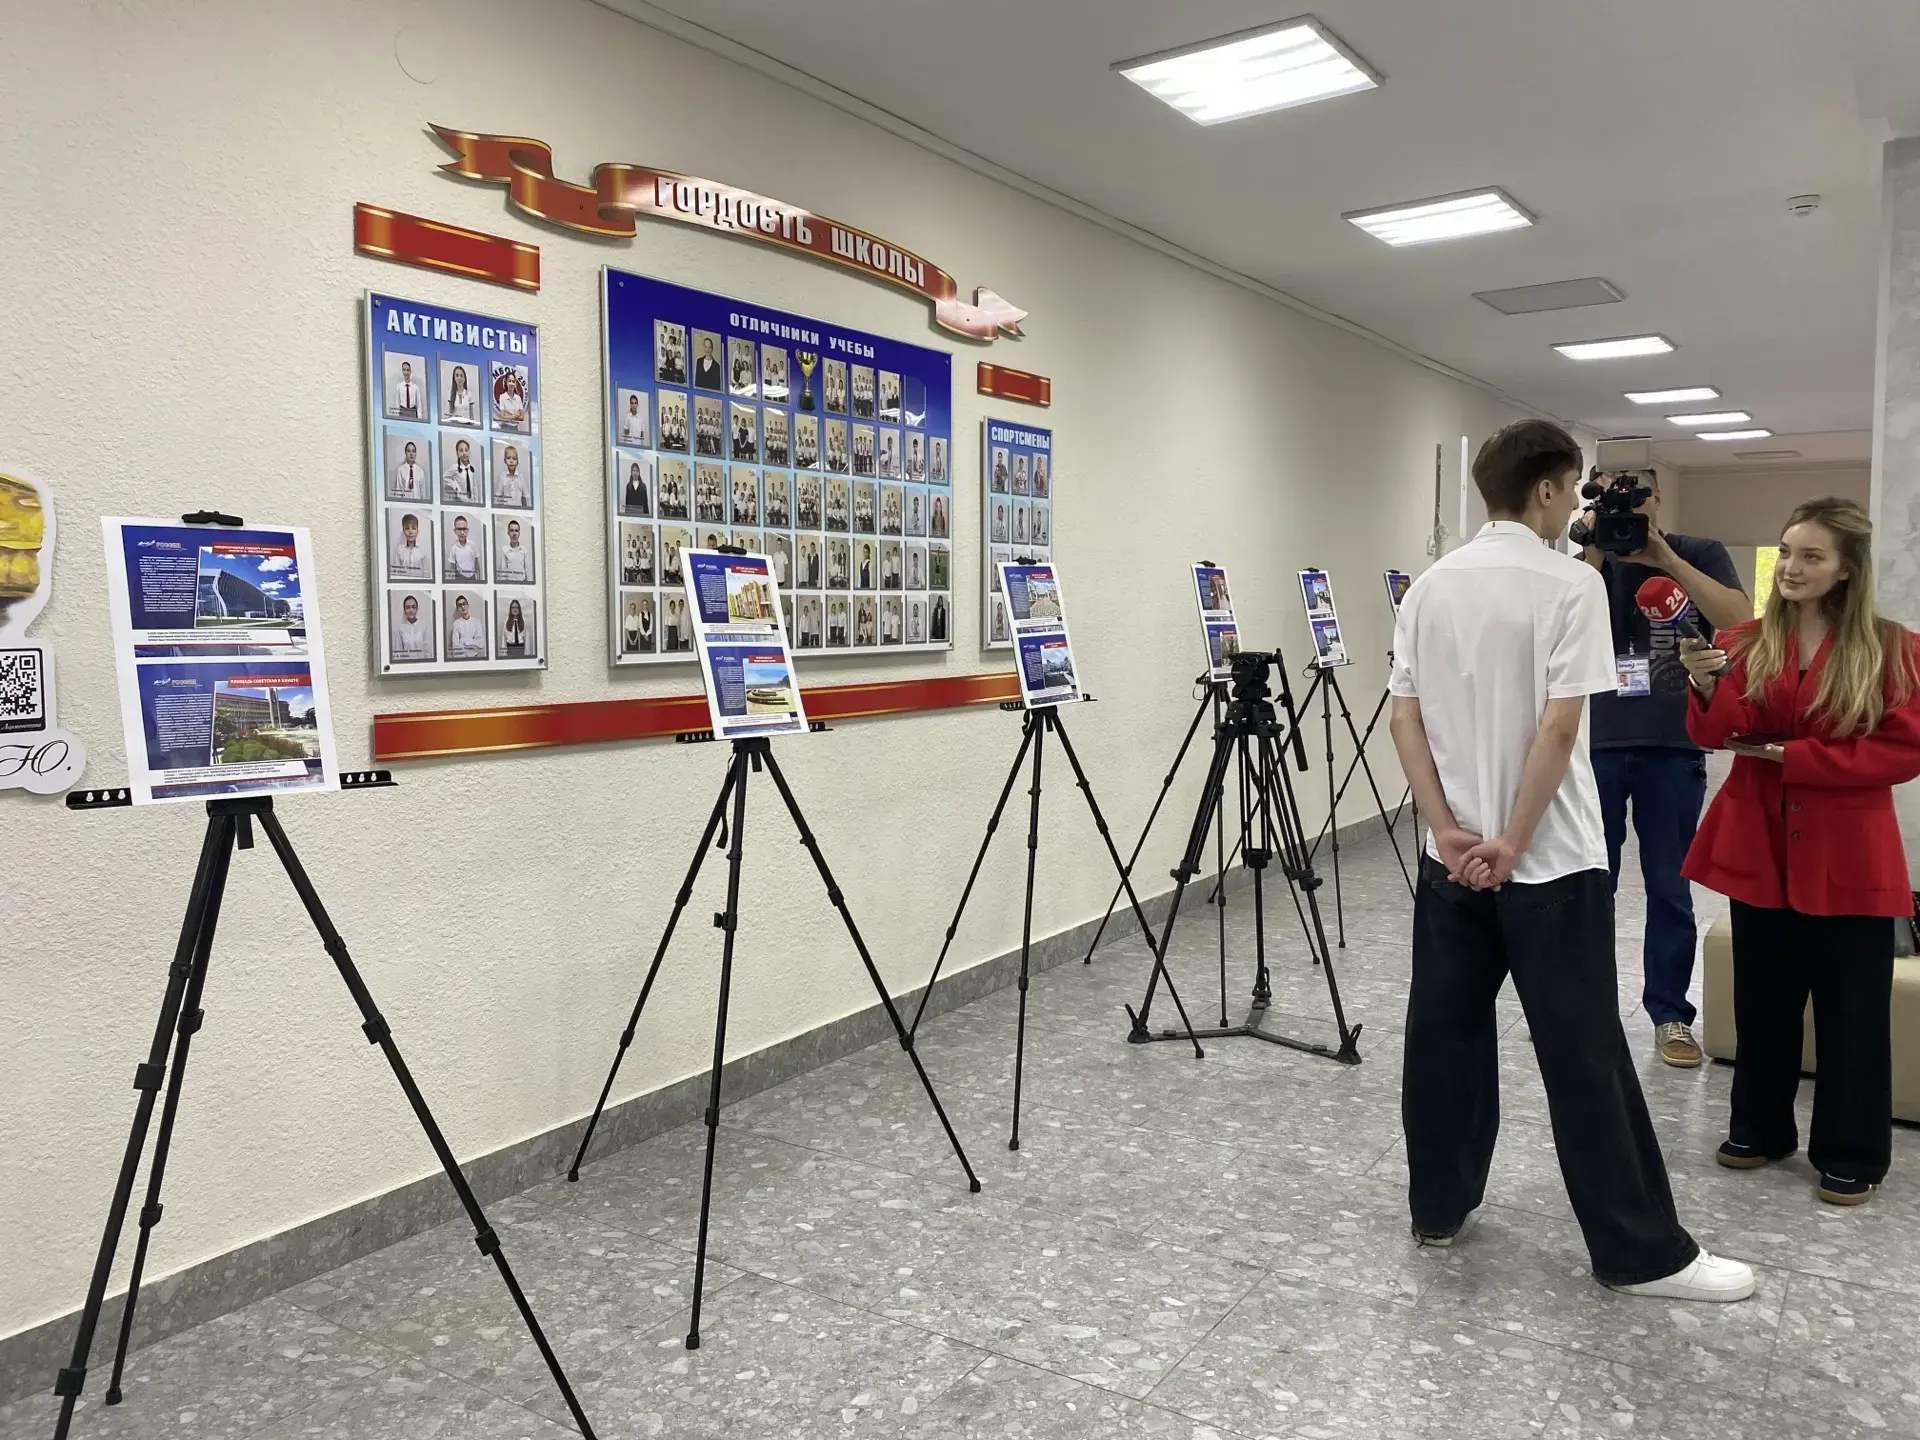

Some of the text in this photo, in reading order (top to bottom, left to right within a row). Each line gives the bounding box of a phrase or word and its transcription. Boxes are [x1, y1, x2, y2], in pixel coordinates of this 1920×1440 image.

[655, 177, 925, 287] ГОРДОСТЬ ШКОЛЫ
[387, 309, 528, 355] АКТИВИСТЫ
[729, 312, 875, 359] ОТЛИЧНИКИ УЧЕБЫ
[991, 426, 1050, 450] СПОРТСМЕНЫ
[1640, 605, 1662, 618] 24
[1665, 587, 1684, 610] 24
